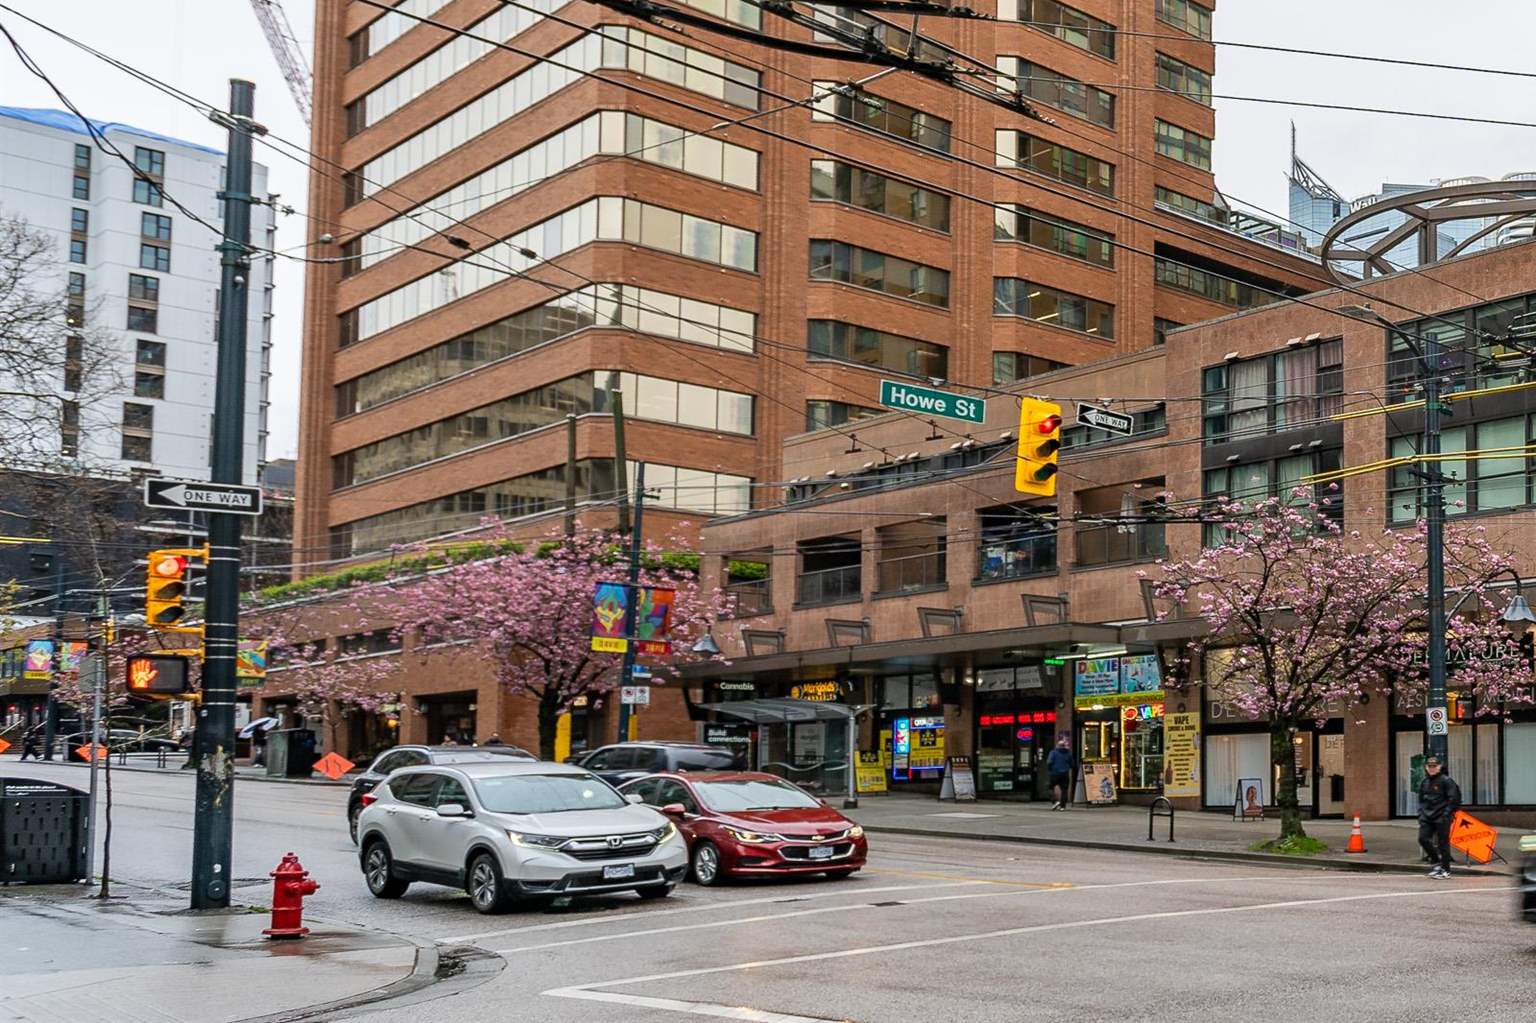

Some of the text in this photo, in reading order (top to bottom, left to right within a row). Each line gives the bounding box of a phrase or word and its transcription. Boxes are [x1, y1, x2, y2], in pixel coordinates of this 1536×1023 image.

[890, 386, 976, 419] Howe St
[1094, 413, 1128, 430] ONE WAY
[183, 490, 248, 504] ONE WAY
[1078, 658, 1118, 674] DAVIE
[720, 681, 755, 691] Cannabis
[1140, 703, 1164, 720] VAPE
[1174, 715, 1189, 725] VAPE
[707, 728, 727, 737] Build
